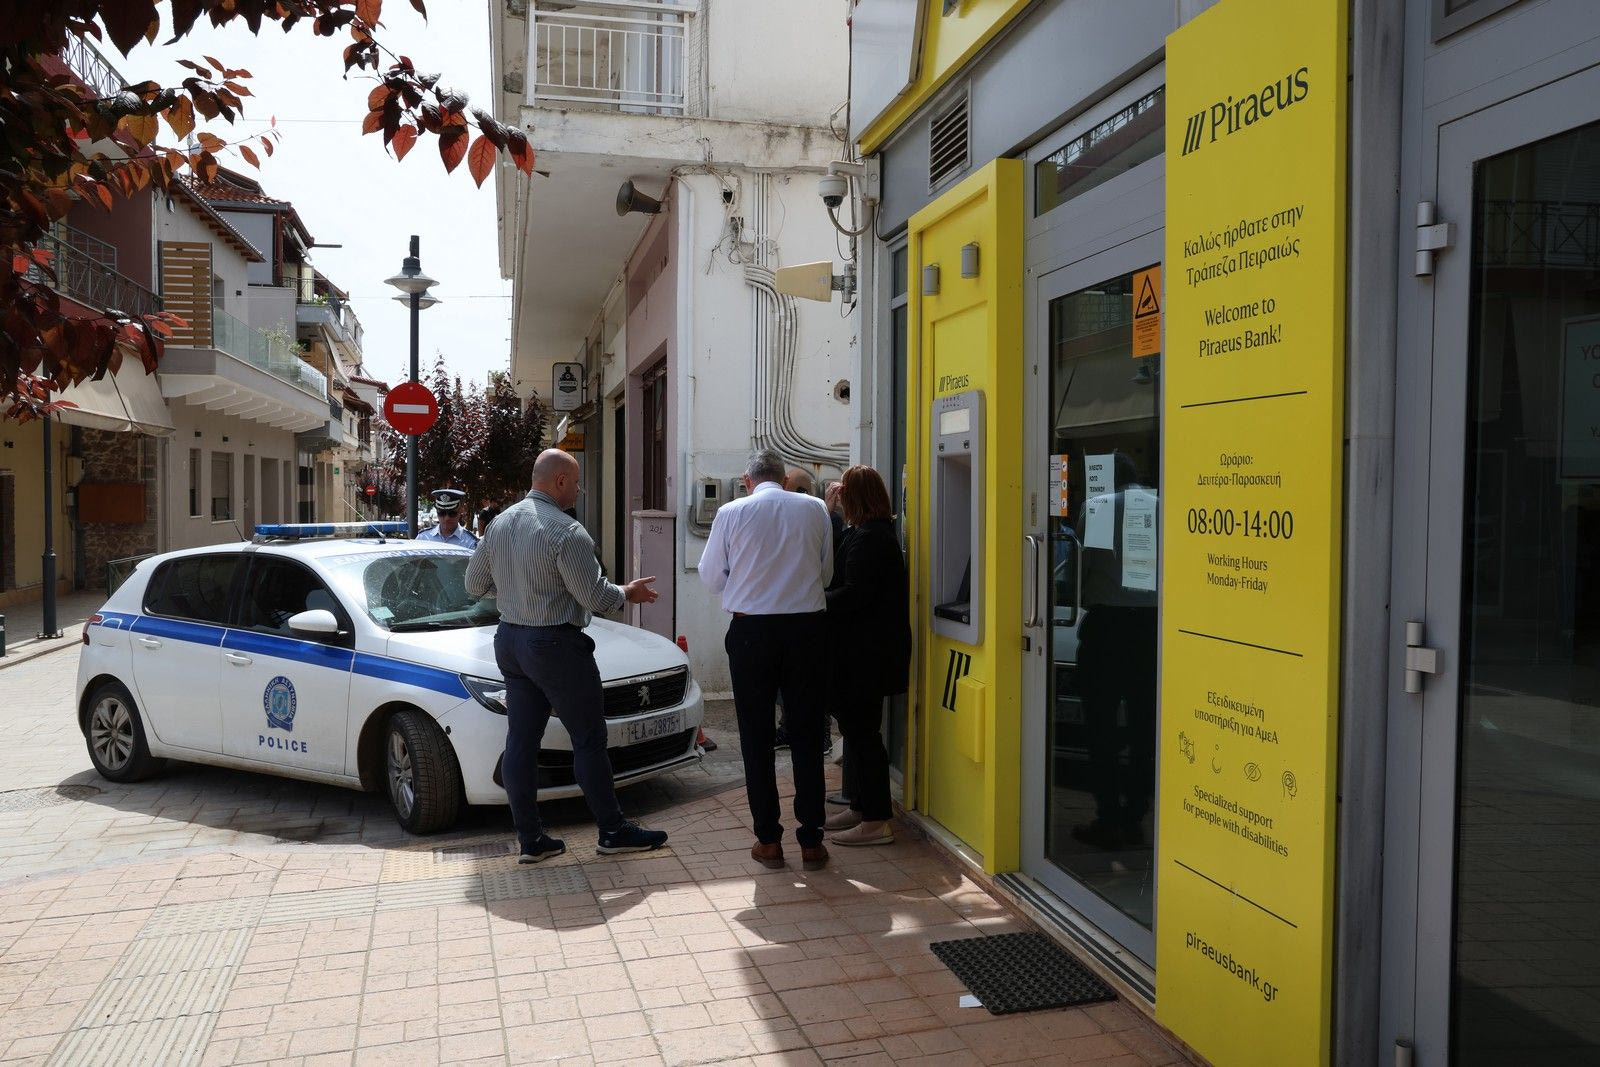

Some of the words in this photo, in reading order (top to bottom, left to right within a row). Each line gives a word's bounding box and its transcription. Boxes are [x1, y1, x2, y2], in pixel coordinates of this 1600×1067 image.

[1209, 66, 1309, 143] Piraeus
[1184, 230, 1222, 258] Καλώς
[1223, 217, 1268, 248] ήρθατε
[1271, 204, 1305, 229] στην
[1186, 256, 1236, 287] Τράπεζα
[1239, 236, 1300, 270] Πειραιώς
[1204, 302, 1259, 326] Welcome
[1262, 298, 1276, 314] to
[1199, 336, 1242, 358] Piraeus
[1245, 324, 1281, 349] Bank!
[946, 374, 969, 391] Piraeus
[1219, 452, 1254, 468] Ωράριο:
[1197, 471, 1281, 488] Δευτέρα-Παρασκευή
[1187, 507, 1294, 540] 08:00-14:00
[1207, 552, 1241, 571] Working
[1241, 557, 1268, 571] Hours
[1207, 572, 1268, 594] Monday-Friday
[1207, 691, 1265, 722] Εξειδικευμένη
[1194, 709, 1240, 735] υποστήριξη
[1241, 723, 1254, 737] για
[1255, 726, 1279, 744] ΑμεΑ
[258, 735, 308, 753] POLICE
[1194, 785, 1238, 814] Specialized
[1239, 805, 1273, 830] support
[1183, 798, 1195, 813] for
[1195, 807, 1222, 827] people
[1222, 818, 1240, 836] with
[1241, 826, 1289, 857] disabilities
[1185, 931, 1279, 1002] piraeusbank.gr
